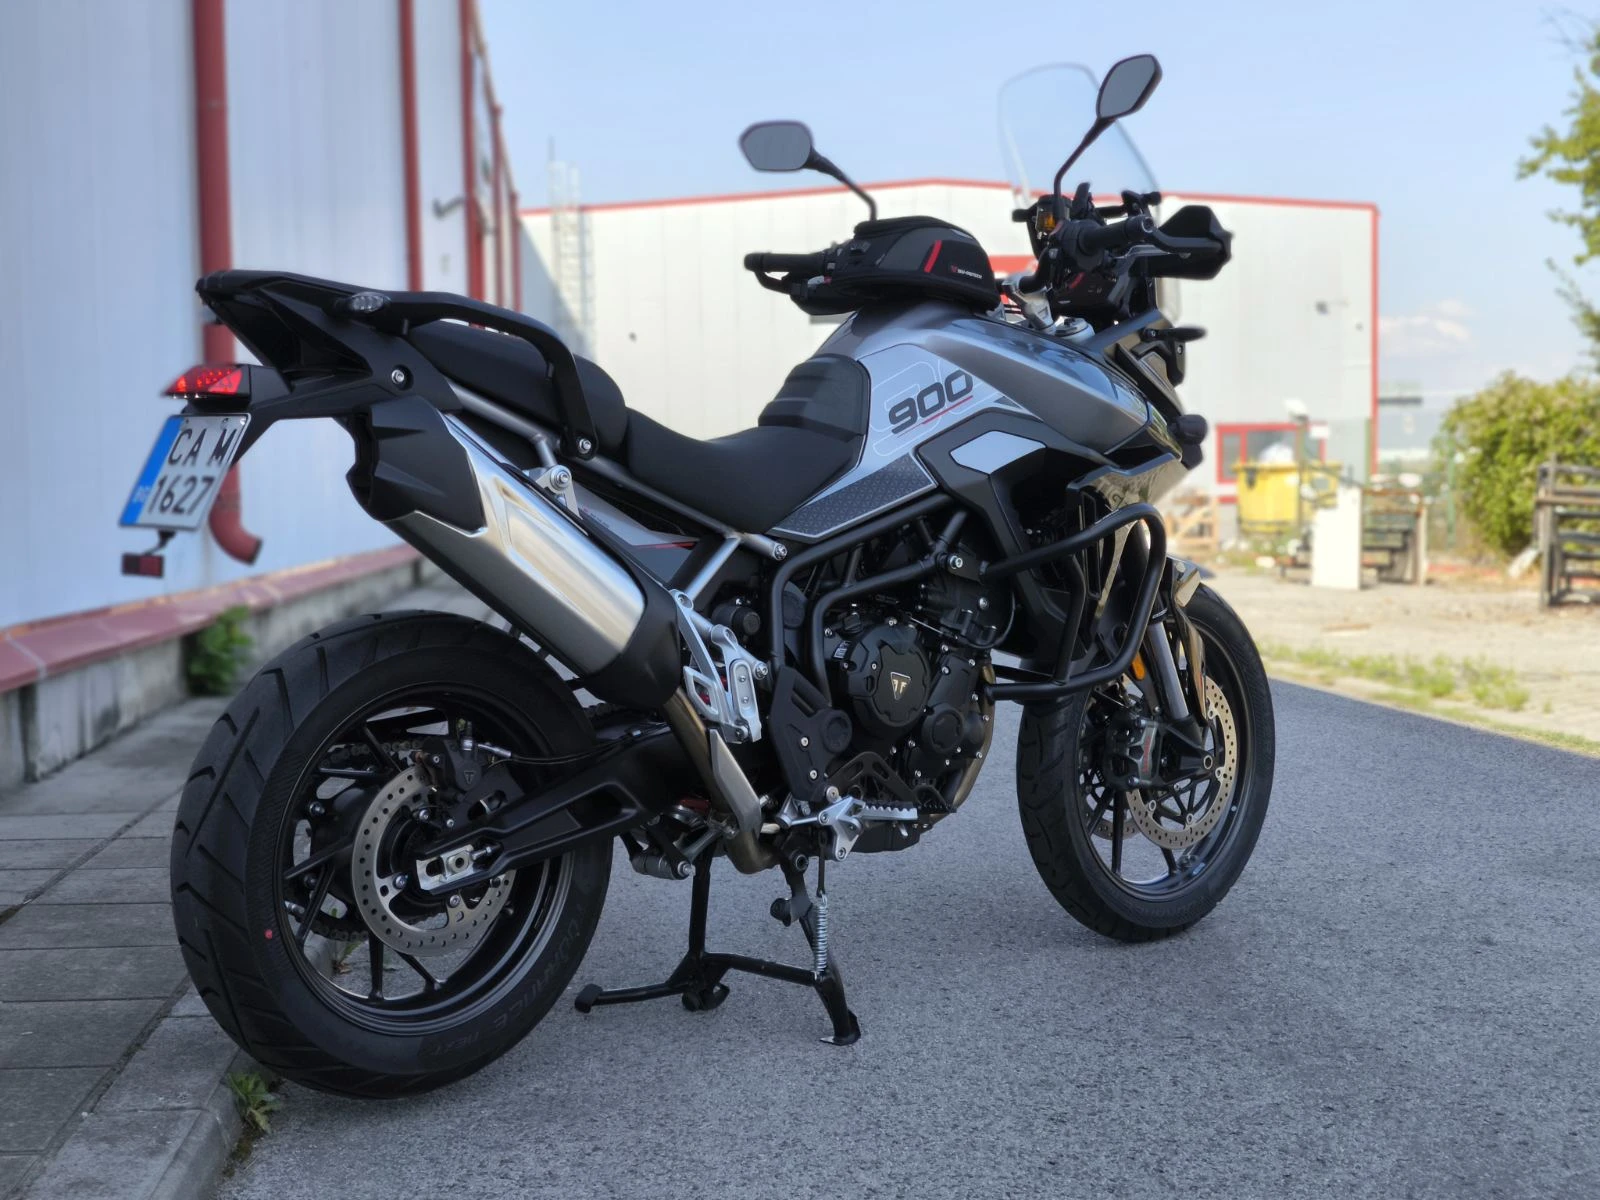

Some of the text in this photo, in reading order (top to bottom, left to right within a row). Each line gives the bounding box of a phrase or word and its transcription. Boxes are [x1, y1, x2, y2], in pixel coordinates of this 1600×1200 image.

[889, 369, 973, 434] 900
[168, 428, 237, 466] CA M
[148, 475, 215, 515] 1627
